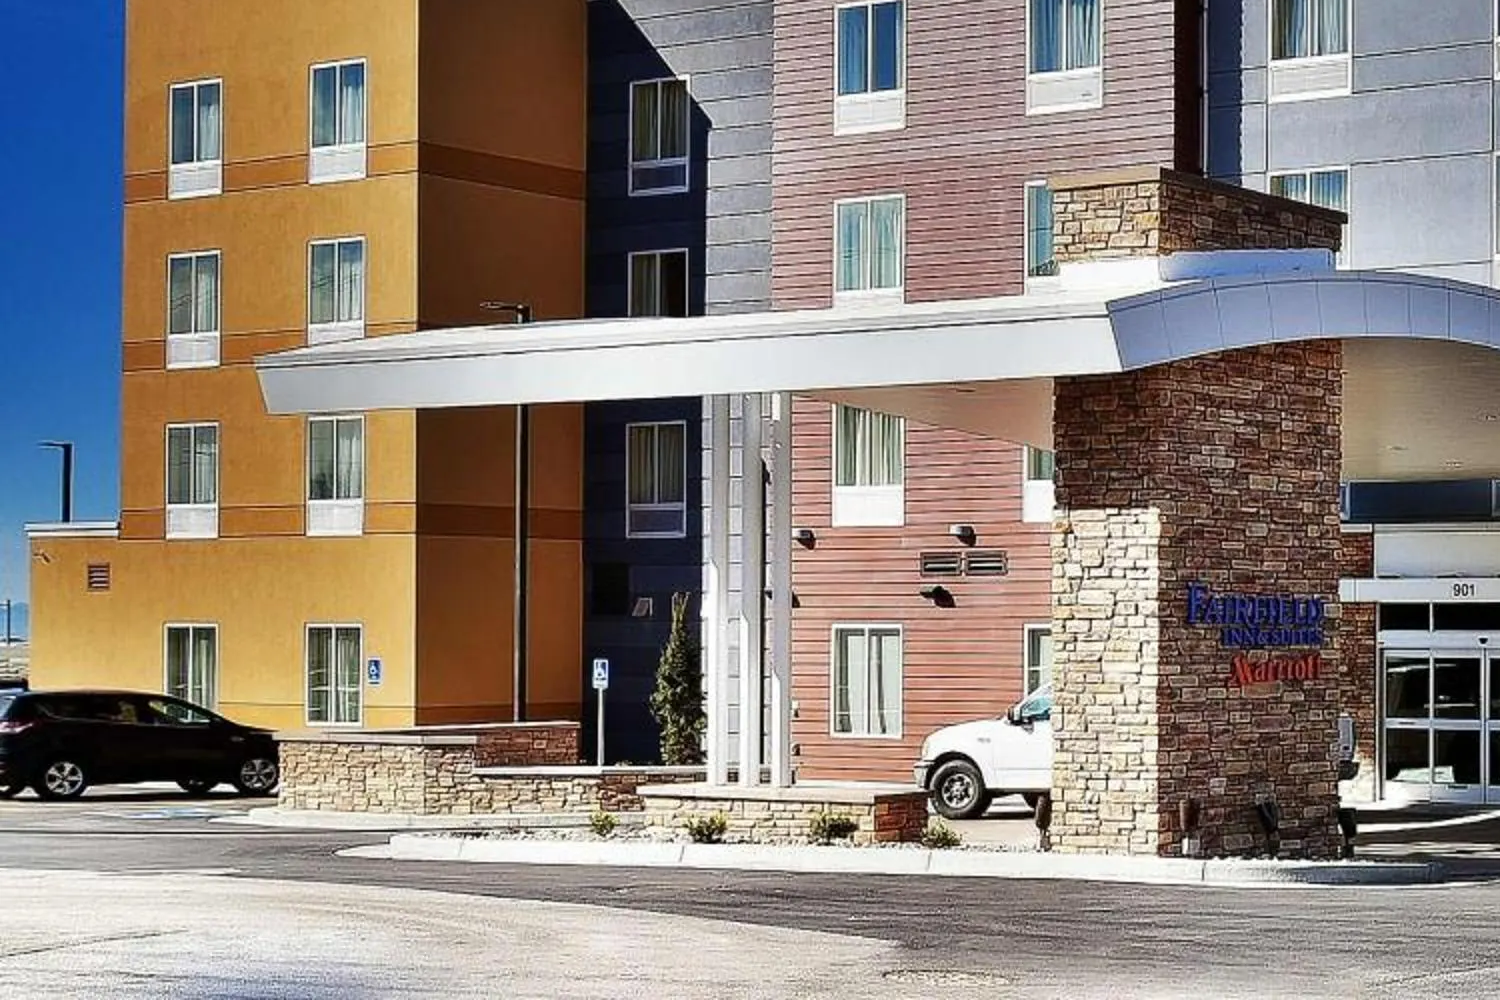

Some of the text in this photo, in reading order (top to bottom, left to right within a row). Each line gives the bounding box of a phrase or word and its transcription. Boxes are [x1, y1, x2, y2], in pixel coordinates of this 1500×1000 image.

[1188, 580, 1321, 626] FAIRFIELD
[1453, 583, 1475, 597] 901
[1230, 651, 1321, 686] Marriott
